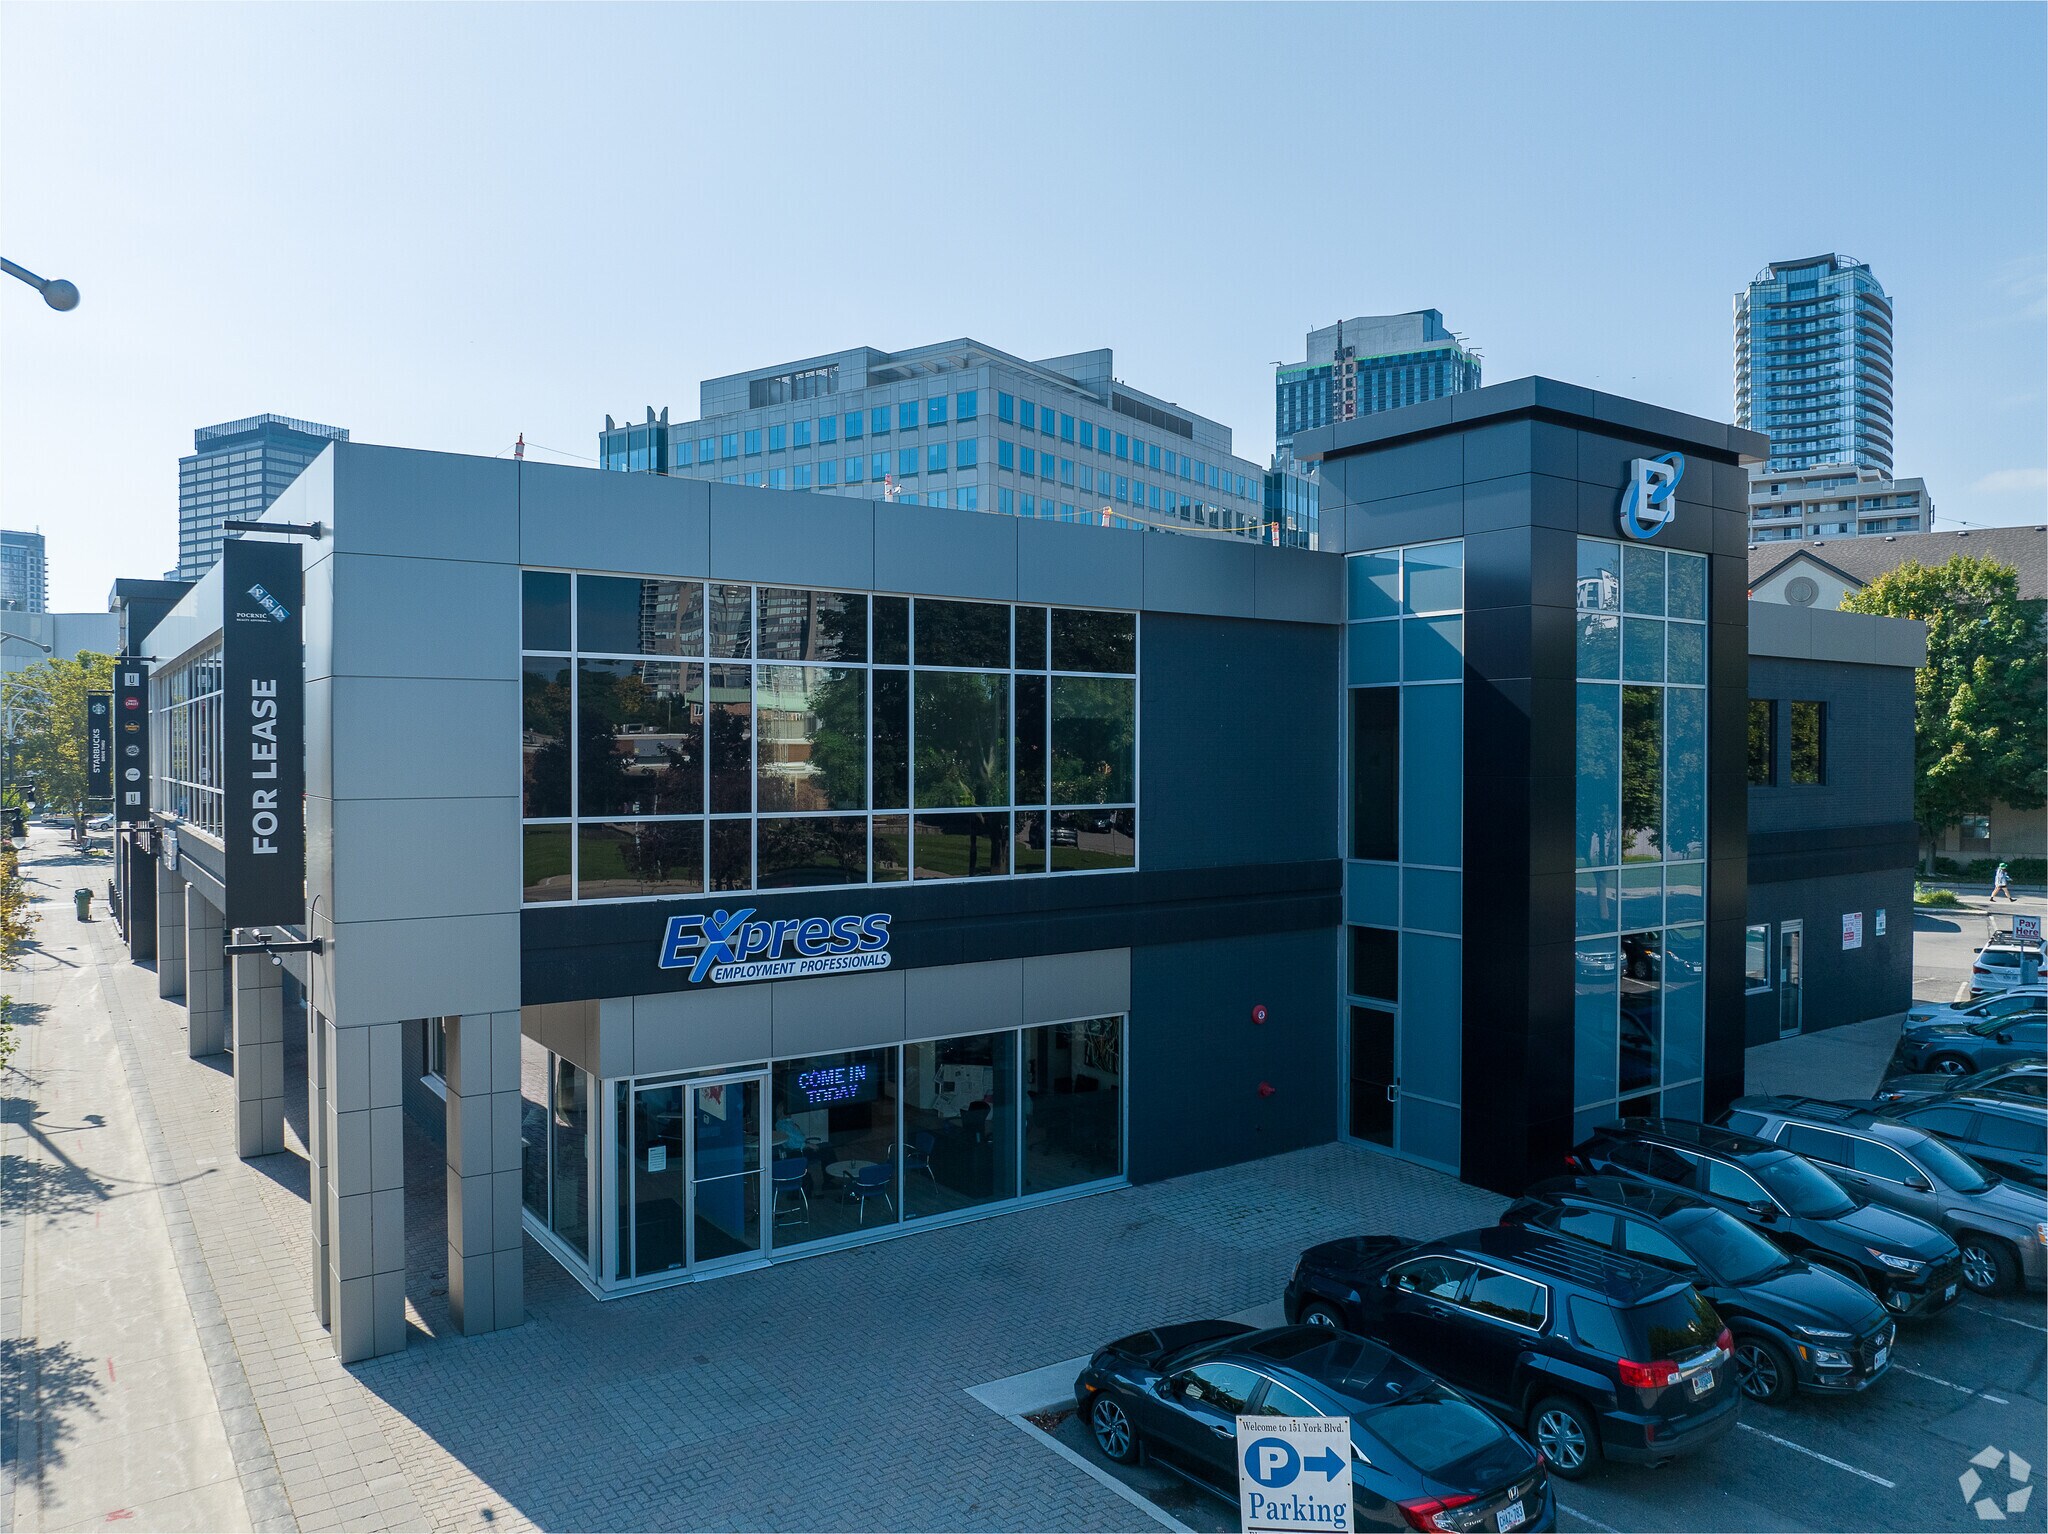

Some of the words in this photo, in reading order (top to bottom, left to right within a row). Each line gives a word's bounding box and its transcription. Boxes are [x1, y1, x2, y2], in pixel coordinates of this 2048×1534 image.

[251, 679, 278, 779] LEASE
[252, 788, 278, 855] FOR
[2016, 927, 2039, 937] Here
[2019, 919, 2037, 929] Pay
[714, 961, 797, 981] EMPLOYMENT
[799, 953, 887, 973] PROFESSIONALS
[799, 1068, 845, 1089] COME
[849, 1064, 866, 1082] IN
[806, 1084, 858, 1103] TODAY
[1242, 1421, 1277, 1432] Welcome
[1279, 1424, 1287, 1432] to
[1289, 1423, 1301, 1432] 151
[1303, 1423, 1322, 1433] York
[1324, 1423, 1344, 1433] Blvd.
[1258, 1446, 1289, 1480] P
[1248, 1492, 1347, 1529] Parking
